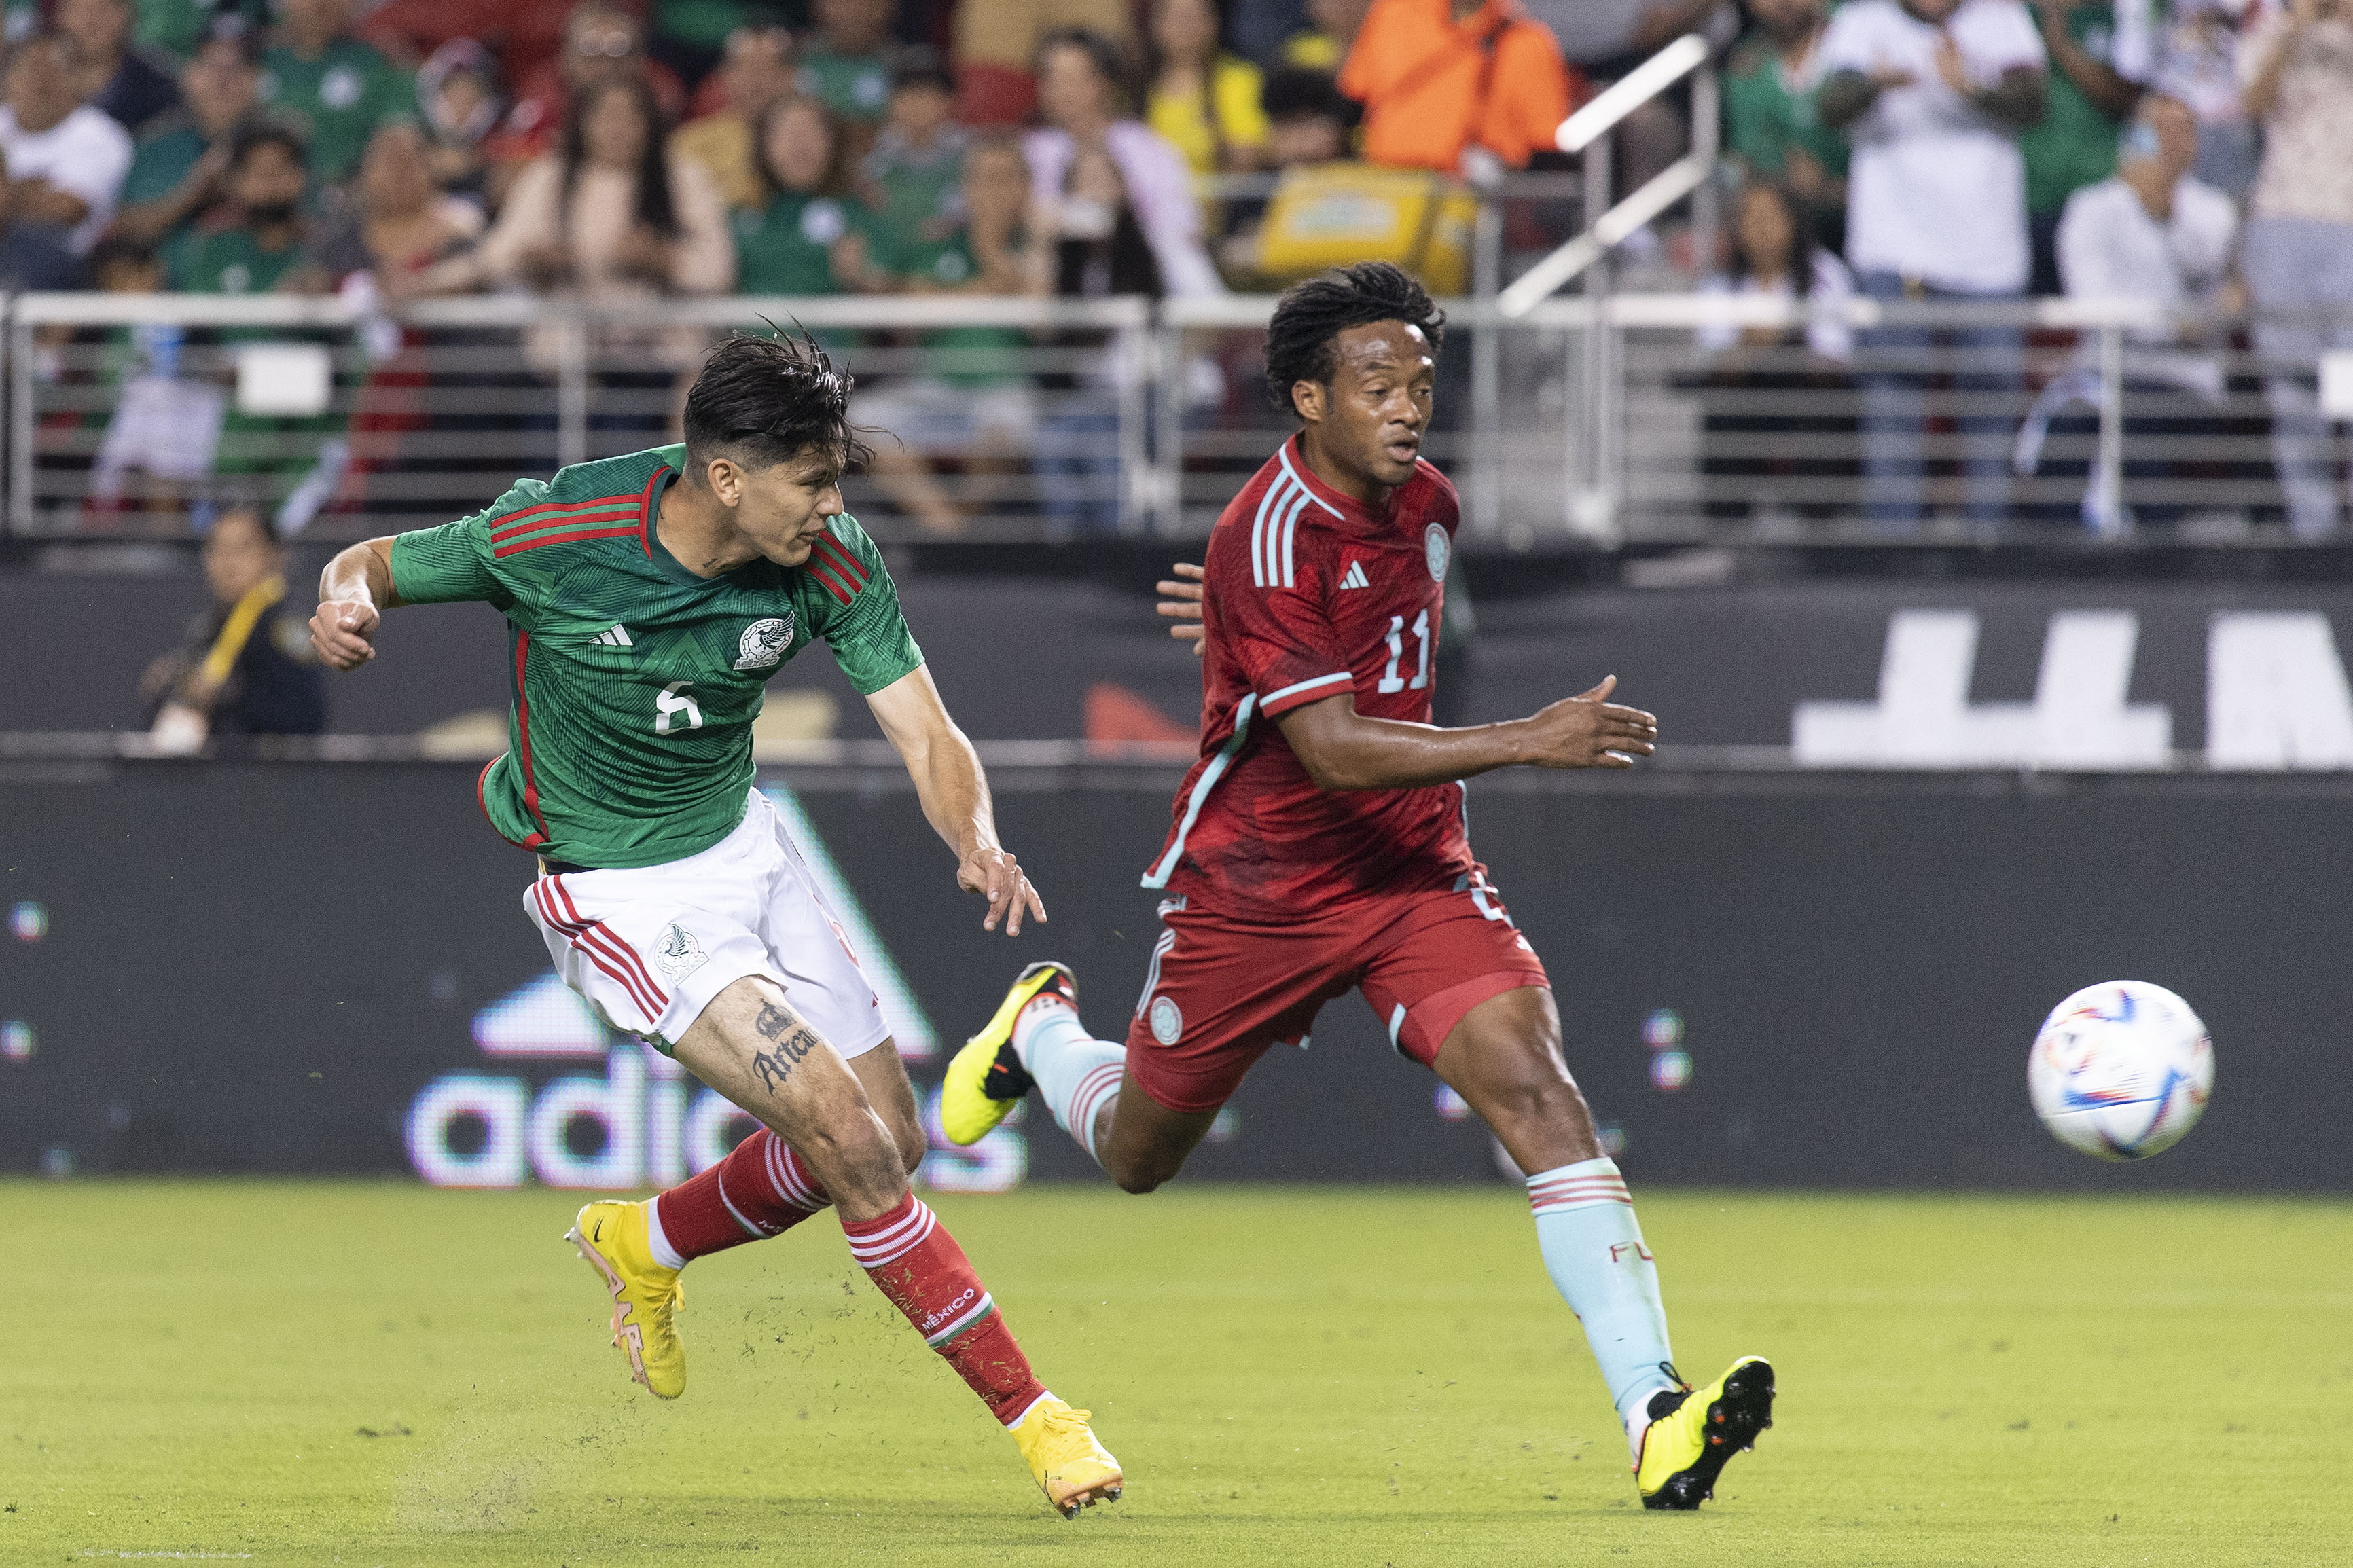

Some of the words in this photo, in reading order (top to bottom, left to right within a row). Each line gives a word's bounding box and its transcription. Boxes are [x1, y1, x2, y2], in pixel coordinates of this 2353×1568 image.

[1378, 608, 1429, 693] 11
[655, 680, 702, 735] 6
[406, 1043, 1028, 1193] adis
